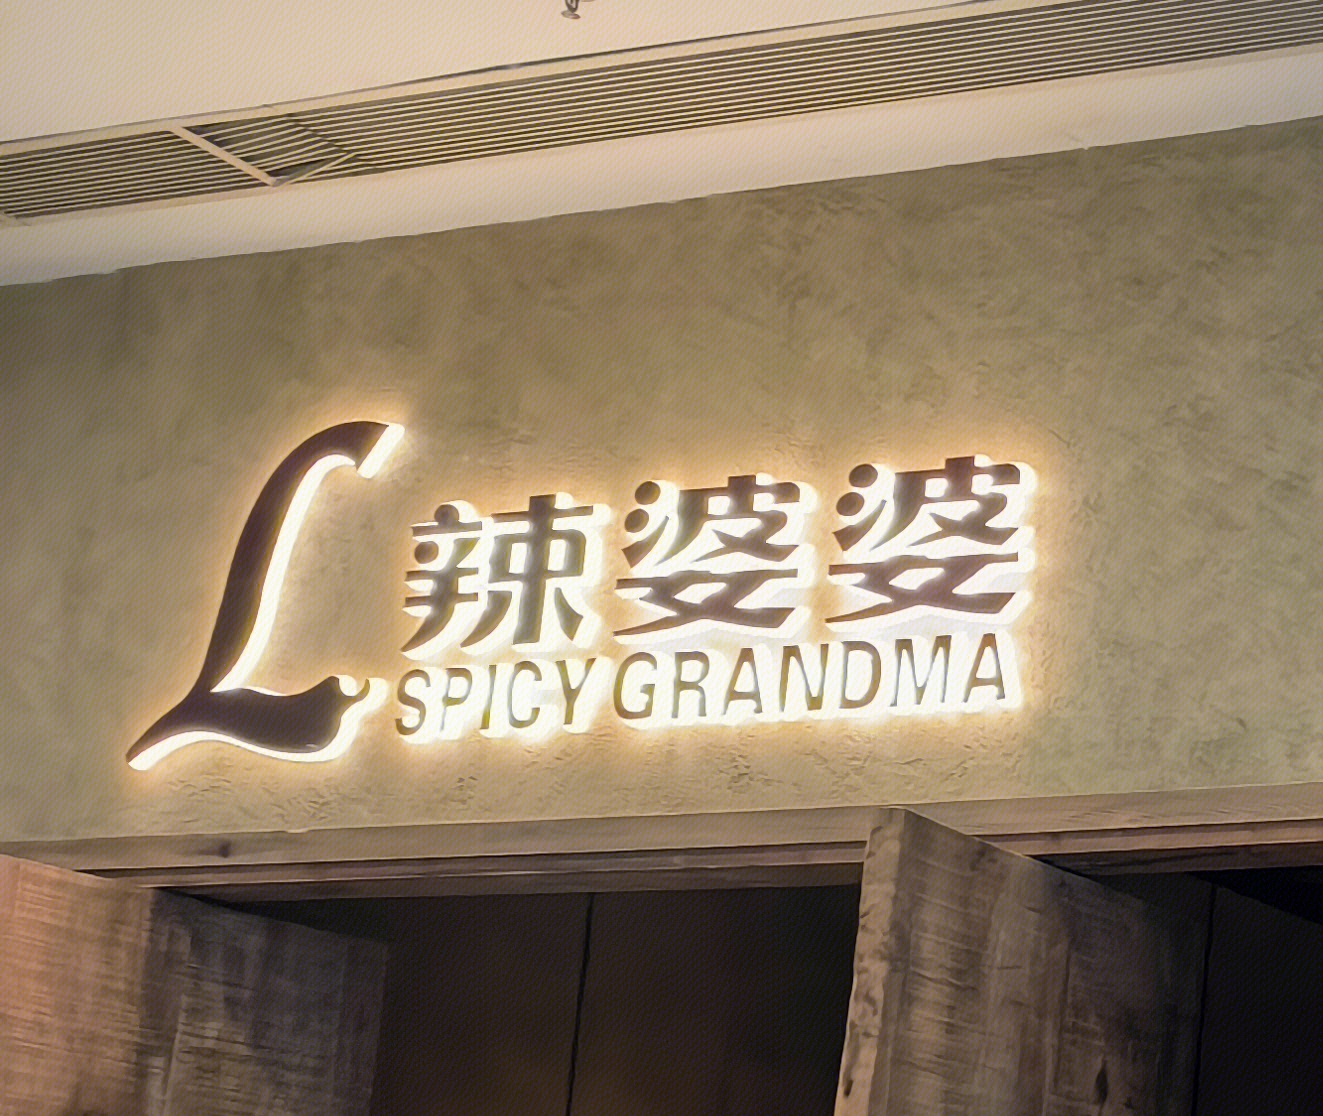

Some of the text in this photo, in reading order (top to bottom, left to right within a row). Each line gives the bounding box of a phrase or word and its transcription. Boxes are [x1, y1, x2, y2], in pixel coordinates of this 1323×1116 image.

[400, 455, 1028, 655] 辣婆婆
[395, 631, 1014, 740] SPICY GRANDMA
